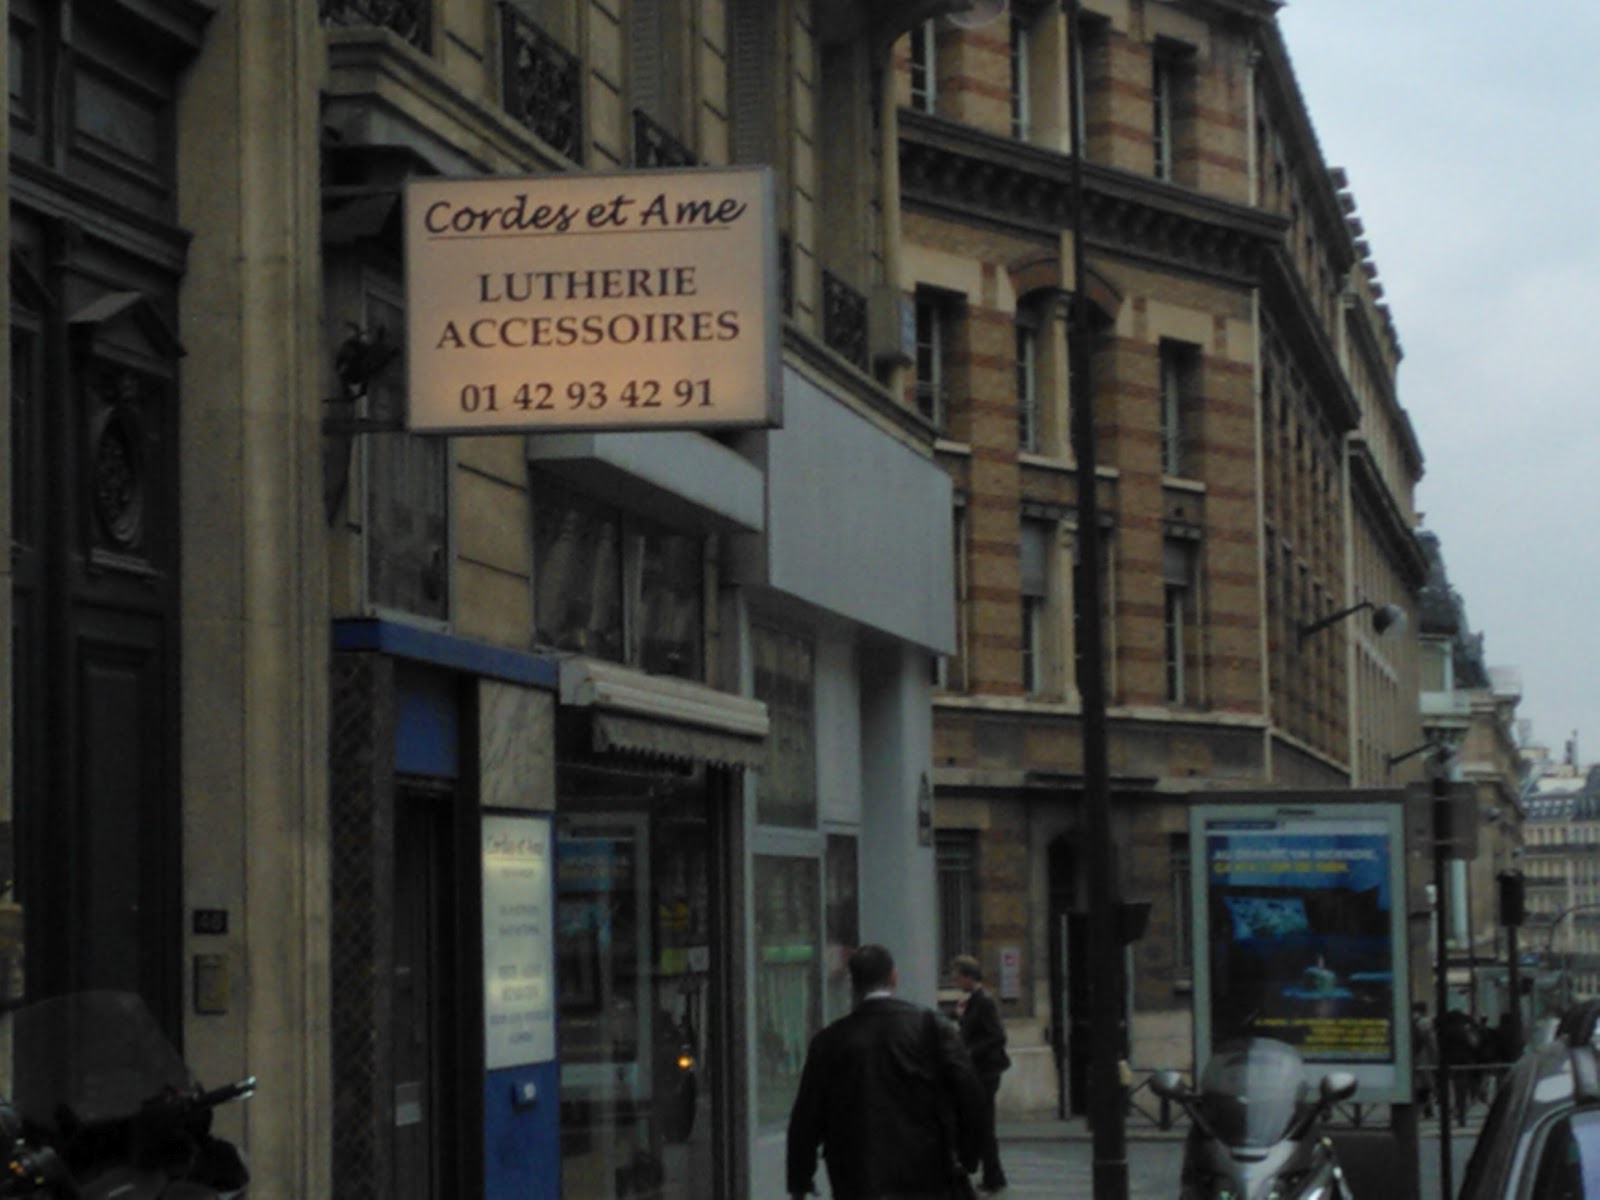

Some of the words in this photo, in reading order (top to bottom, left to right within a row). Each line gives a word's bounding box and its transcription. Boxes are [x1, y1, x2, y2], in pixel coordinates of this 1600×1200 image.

[424, 193, 579, 233] Cordes
[586, 194, 636, 228] et
[640, 193, 747, 226] Ame
[477, 266, 698, 303] LUTHERIE
[435, 310, 741, 350] ACCESSOIRES
[459, 383, 499, 413] 01
[512, 382, 555, 411] 42
[565, 380, 608, 410] 93
[619, 379, 662, 409] 42
[673, 378, 716, 408] 91
